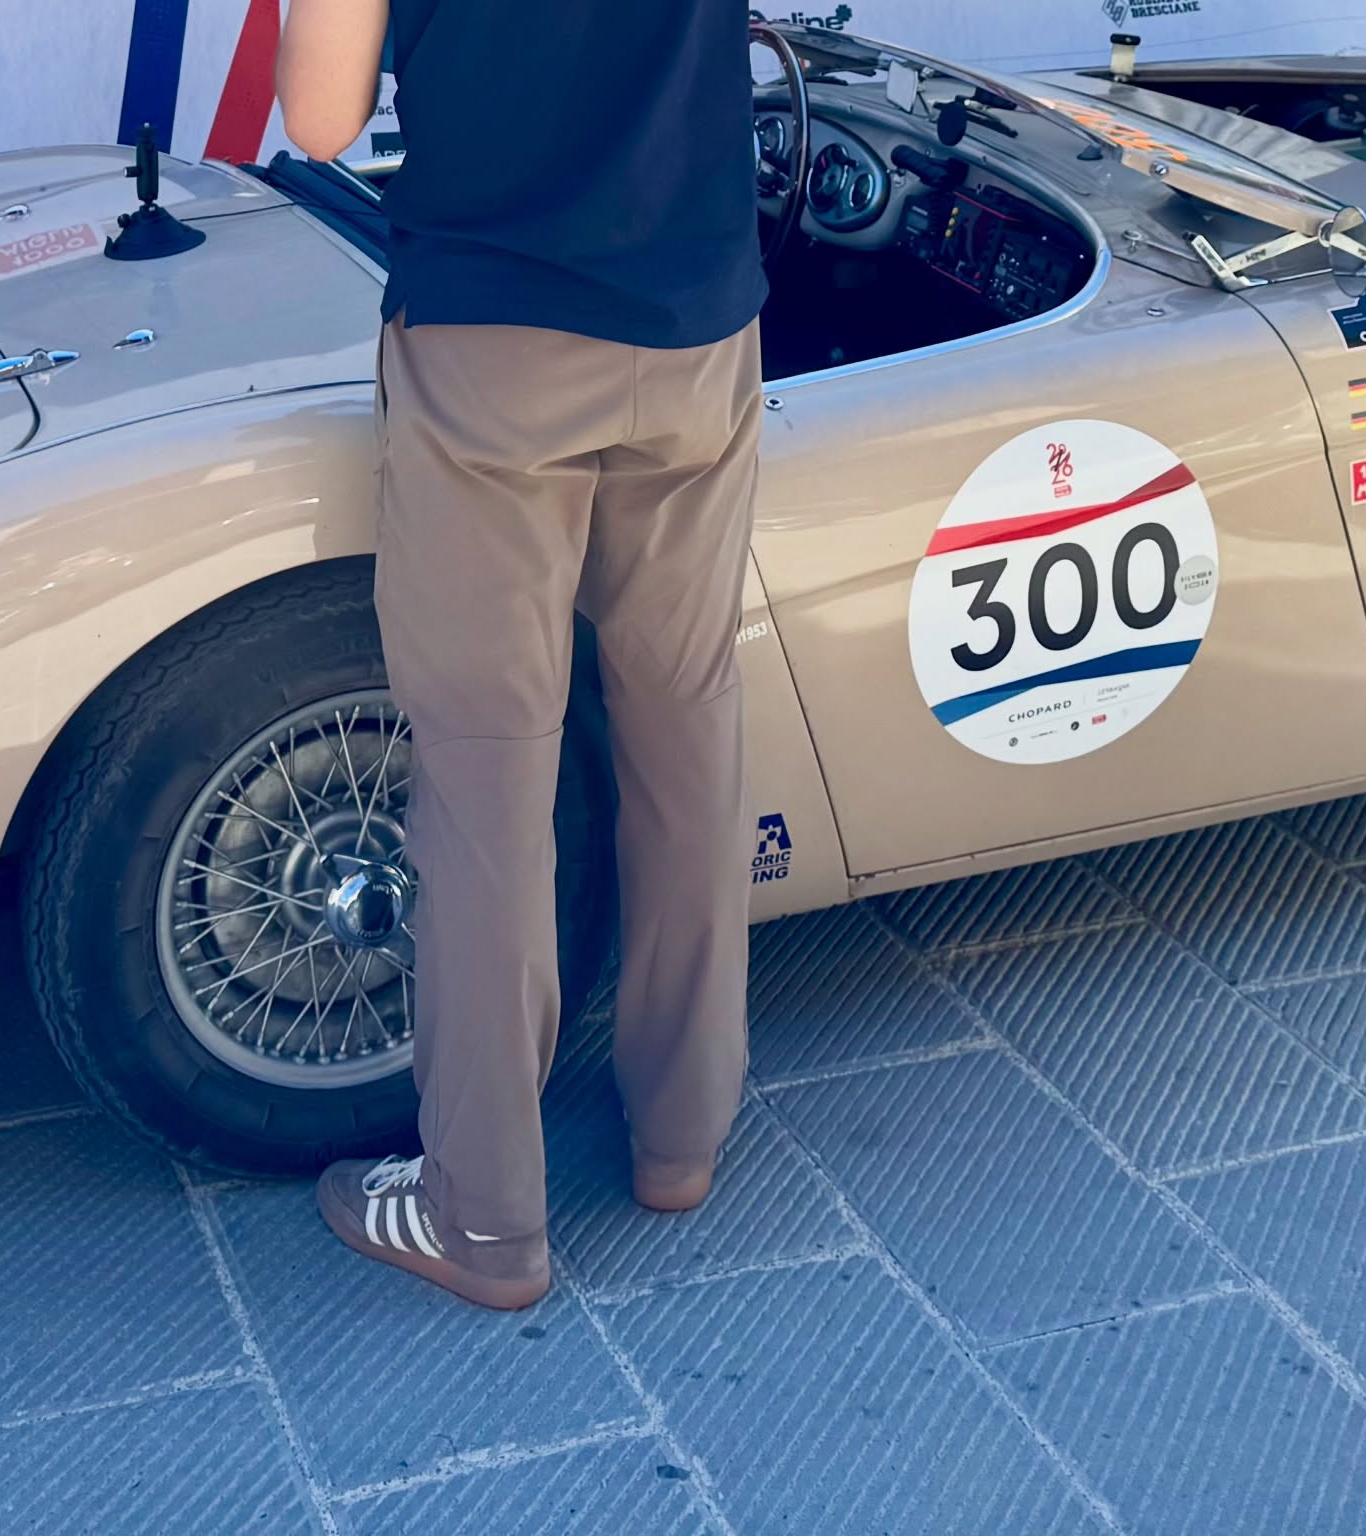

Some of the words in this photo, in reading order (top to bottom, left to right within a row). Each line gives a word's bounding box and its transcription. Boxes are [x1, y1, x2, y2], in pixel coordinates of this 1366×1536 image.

[1131, 1, 1201, 18] BRESCIANE
[951, 522, 1180, 672] 300
[1008, 699, 1072, 723] CHOPARD
